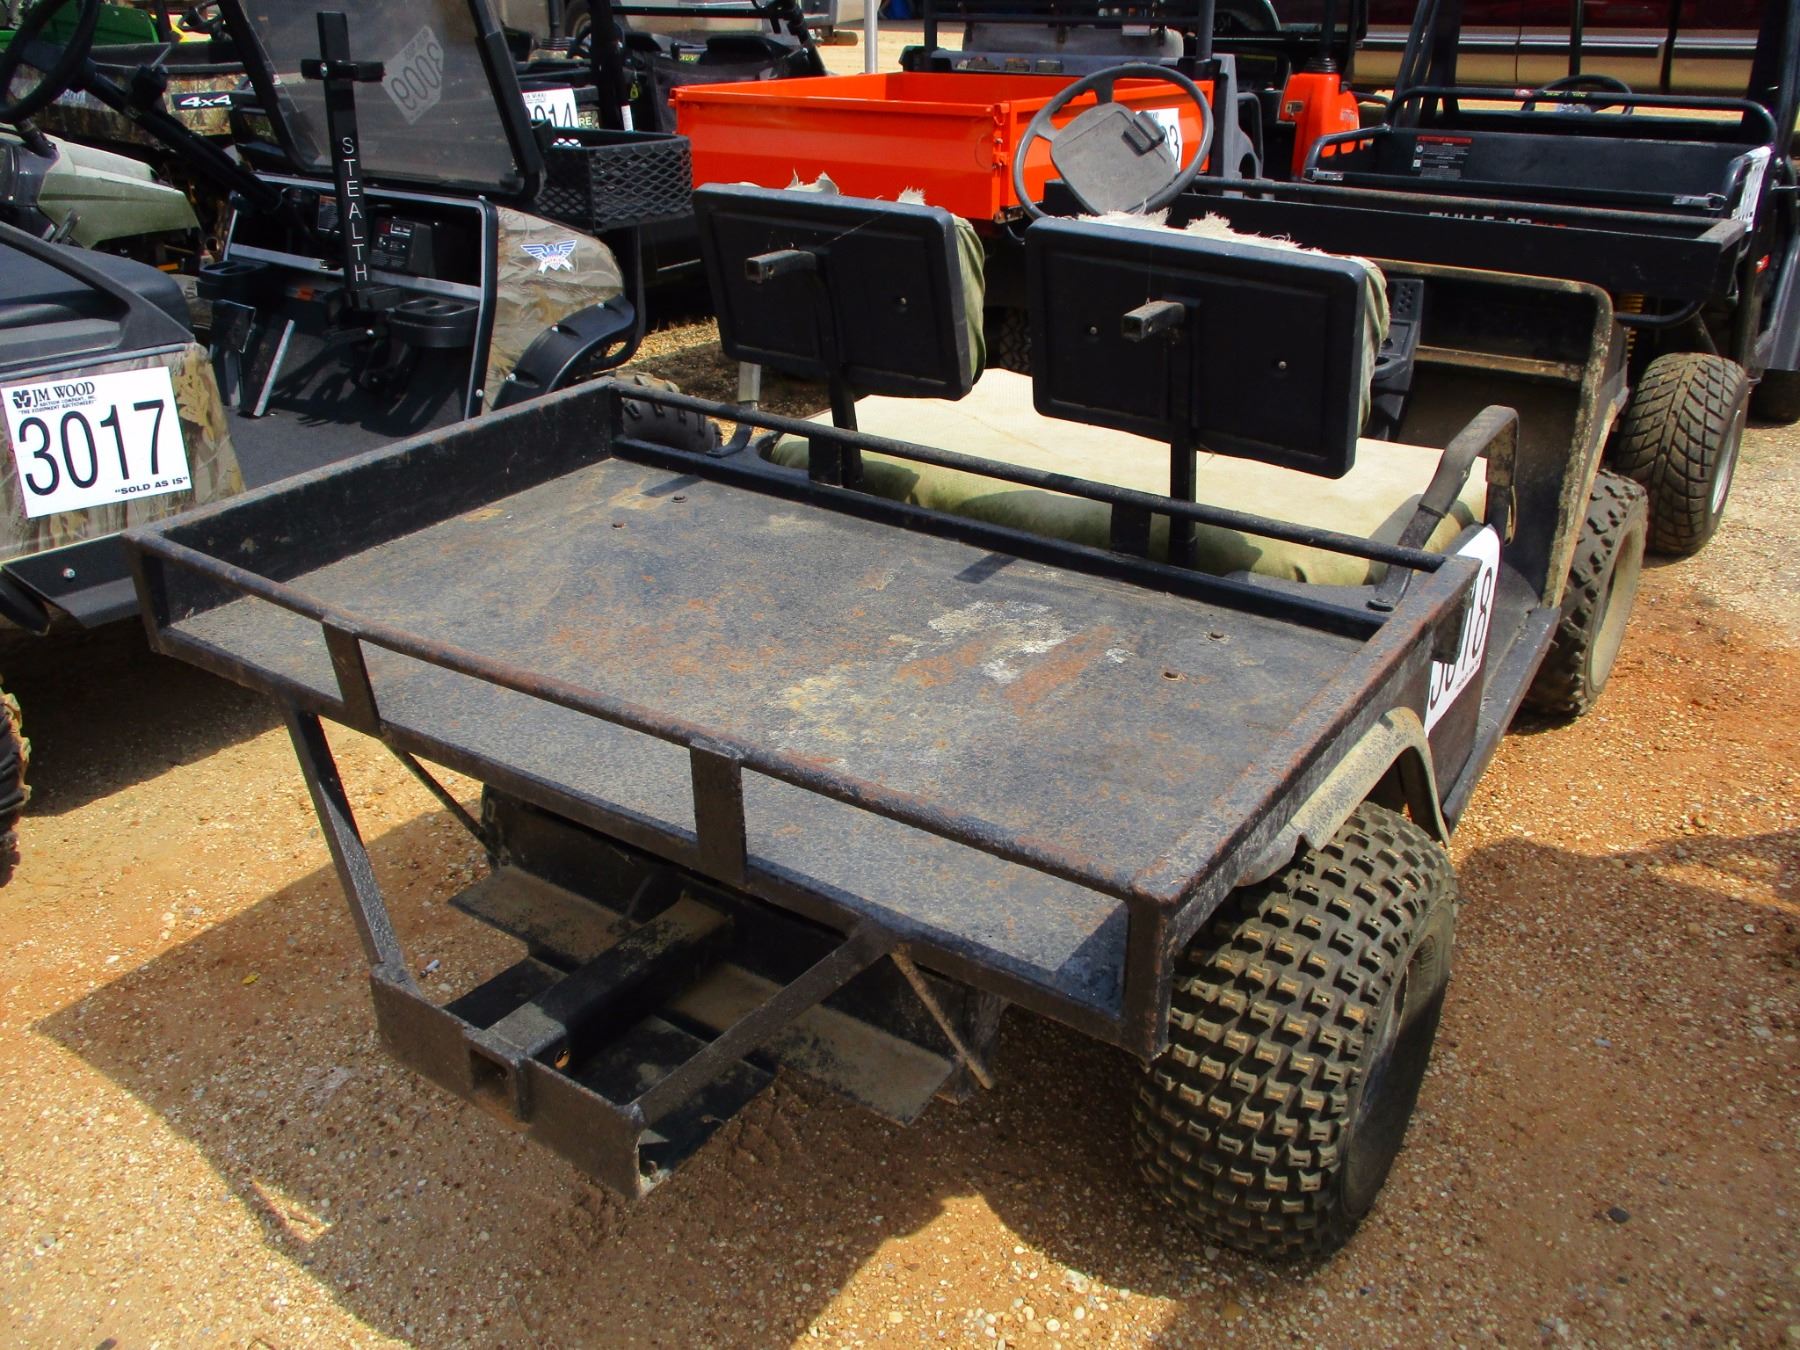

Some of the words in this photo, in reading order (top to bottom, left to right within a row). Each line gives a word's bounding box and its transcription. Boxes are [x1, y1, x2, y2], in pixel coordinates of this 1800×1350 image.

[180, 95, 232, 107] 4x4
[341, 137, 368, 282] STEALTH
[32, 387, 50, 408] JM
[53, 381, 95, 399] WOOD
[18, 399, 165, 496] 3017
[154, 480, 169, 489] AS
